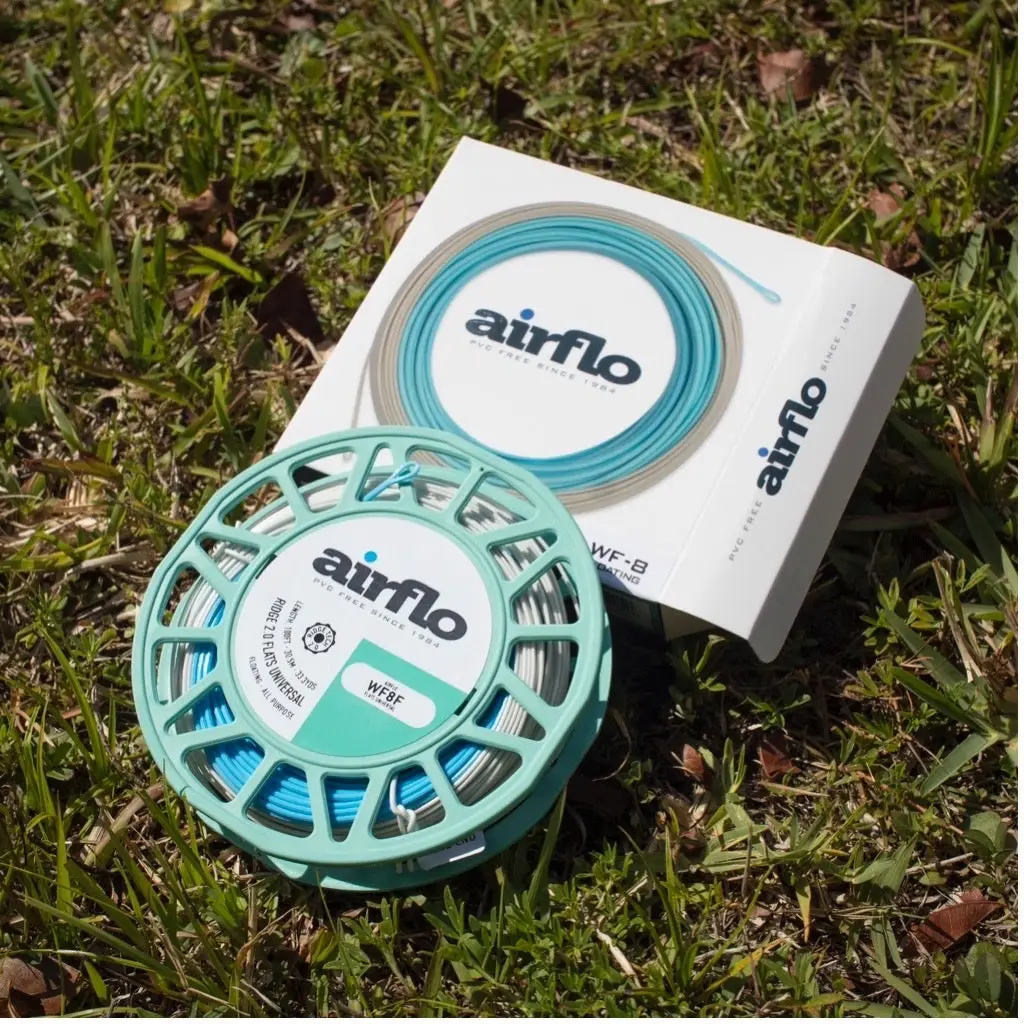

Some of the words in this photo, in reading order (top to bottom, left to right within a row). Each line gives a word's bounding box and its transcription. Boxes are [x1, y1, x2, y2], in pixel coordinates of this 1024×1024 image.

[465, 308, 641, 385] airflo
[469, 339, 492, 352] PVC
[499, 350, 529, 365] FREE
[536, 362, 576, 381] SINCE
[584, 379, 616, 395] 1984
[743, 500, 762, 532] FREE
[757, 377, 826, 496] airflo
[820, 336, 840, 371] SINCE
[840, 303, 856, 330] 1984
[591, 542, 648, 575] WF-8
[596, 562, 641, 585] OATING
[266, 597, 286, 623] RIDGE
[312, 547, 467, 641] airflo
[312, 577, 334, 592] PVC
[338, 591, 366, 610] FREE
[370, 608, 406, 631] SINCE
[411, 630, 441, 648] 1984
[262, 625, 275, 640] 2.0
[306, 626, 327, 638] RIDGE
[262, 641, 278, 668] FLATS
[248, 656, 262, 685] FLOATING
[261, 687, 271, 700] ALL
[269, 697, 295, 721] PURPOSE
[268, 666, 306, 708] UNIVERSAL
[367, 680, 405, 705] WF8F
